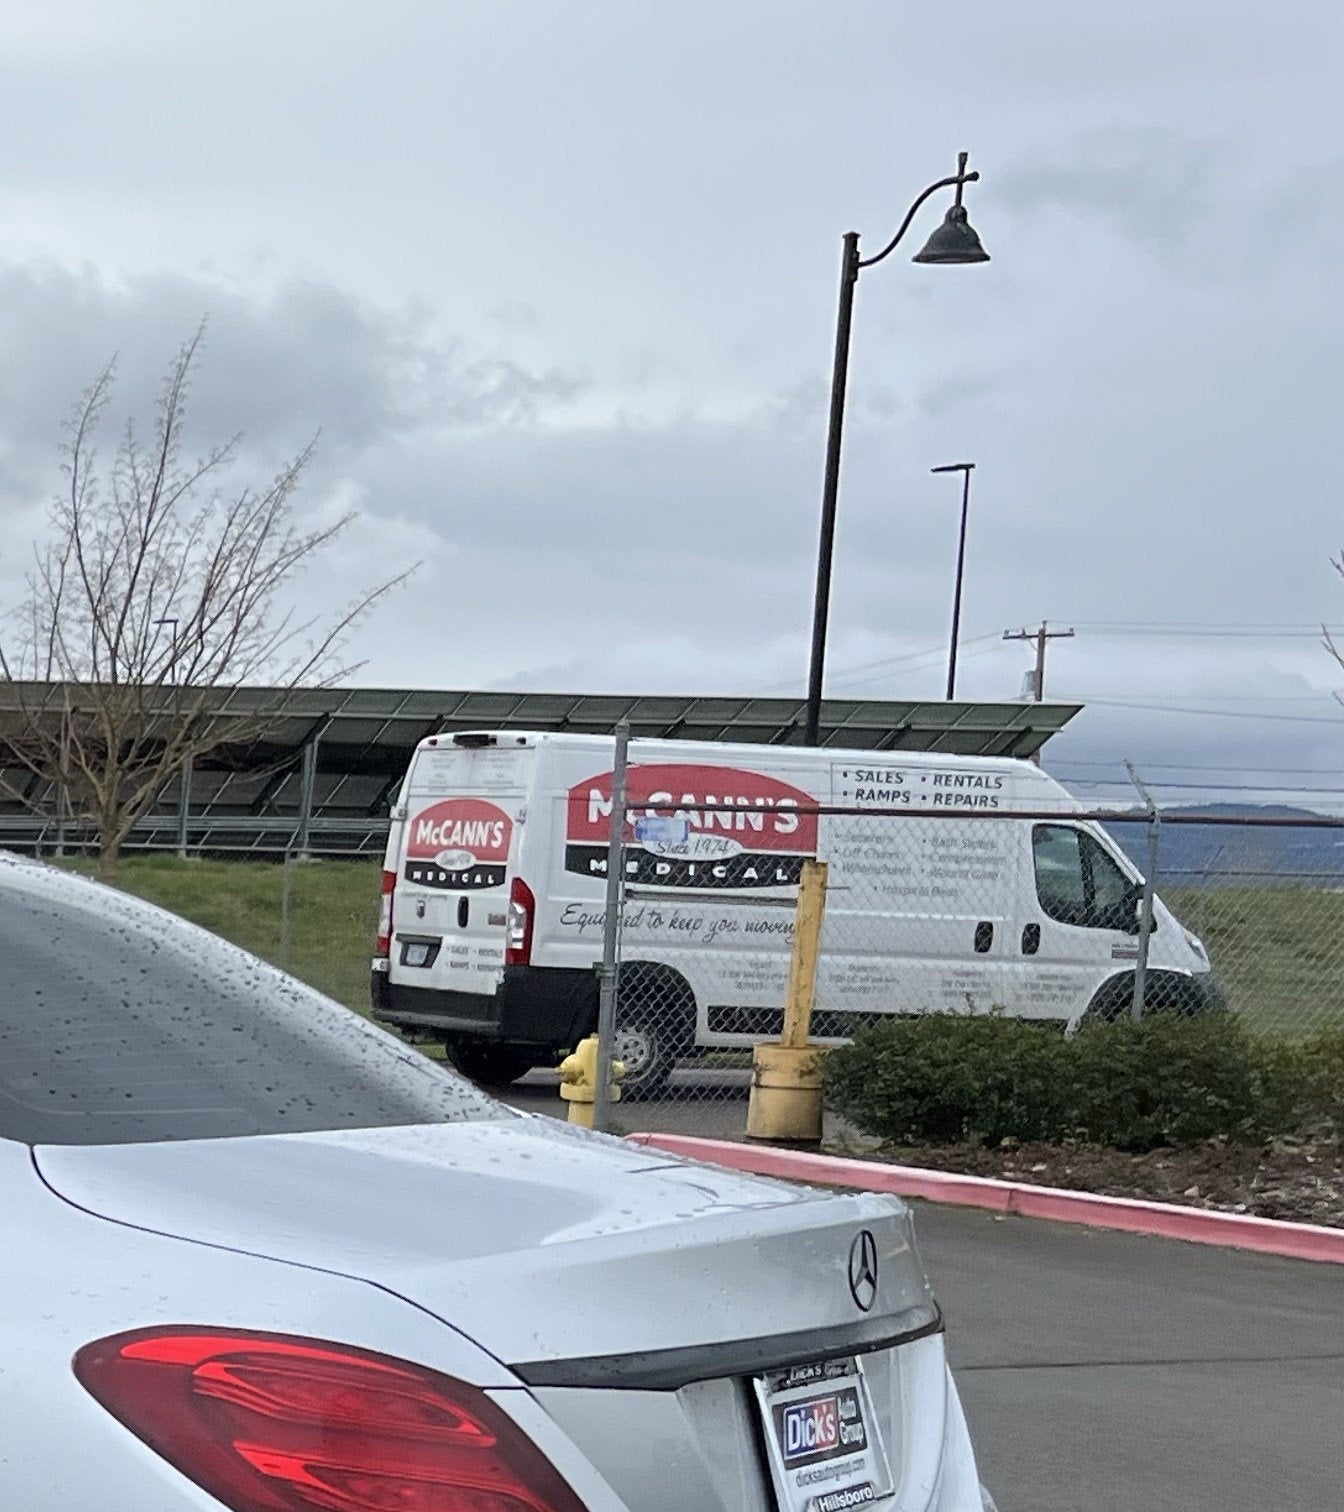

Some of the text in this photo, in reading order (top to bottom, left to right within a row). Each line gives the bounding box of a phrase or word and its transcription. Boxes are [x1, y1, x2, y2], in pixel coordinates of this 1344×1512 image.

[855, 770, 904, 784] SALES
[933, 774, 1003, 789] RENTALS
[855, 788, 911, 803] RAMPS
[933, 793, 999, 808] REPAIRS
[416, 819, 504, 848] McCANN'S
[589, 858, 788, 881] MEDICAL
[413, 871, 495, 884] MEDICAL
[560, 903, 646, 935] Equied
[647, 909, 664, 929] to
[669, 910, 703, 938] keep
[701, 919, 738, 944] you
[787, 1403, 836, 1452] Dick's
